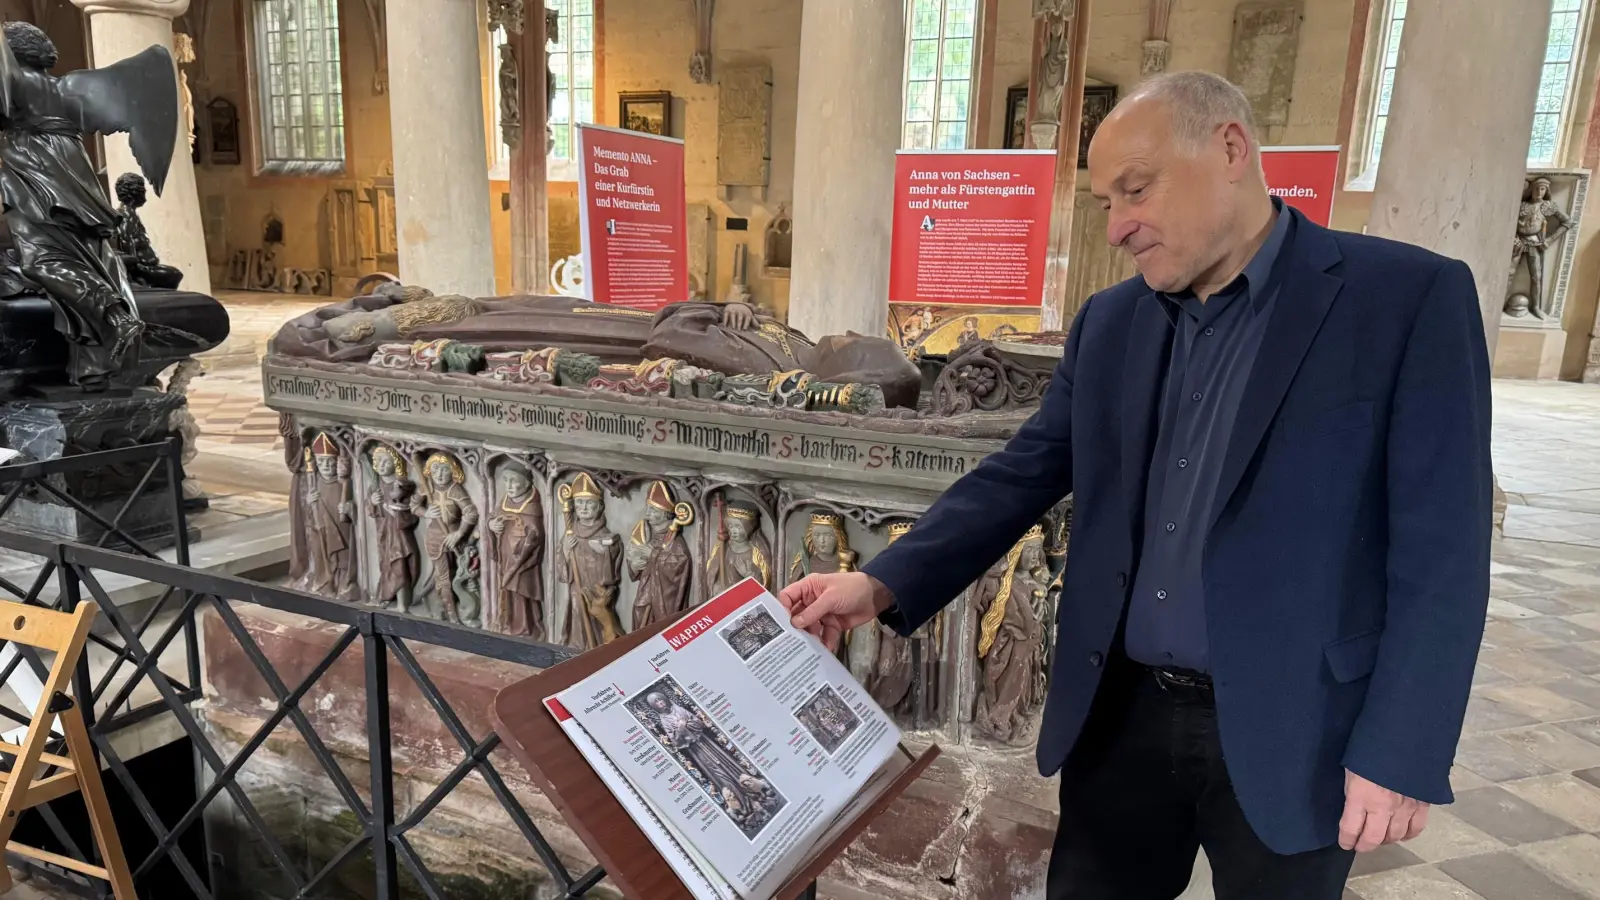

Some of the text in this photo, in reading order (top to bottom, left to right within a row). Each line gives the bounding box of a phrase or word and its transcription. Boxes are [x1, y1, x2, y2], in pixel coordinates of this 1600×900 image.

[593, 145, 629, 162] Memento
[630, 152, 652, 165] ANNA
[594, 162, 629, 178] Das Grab
[909, 169, 939, 180] Anna
[941, 171, 961, 180] von
[963, 169, 1010, 180] Sachsen
[595, 179, 655, 197] einer Kurfürstin
[909, 184, 1035, 197] mehr als Fürstengattin
[1265, 185, 1318, 199] emden,
[596, 196, 661, 212] und Netzwerkerin
[908, 199, 969, 210] und Mutter
[669, 615, 713, 648] WAPPEN
